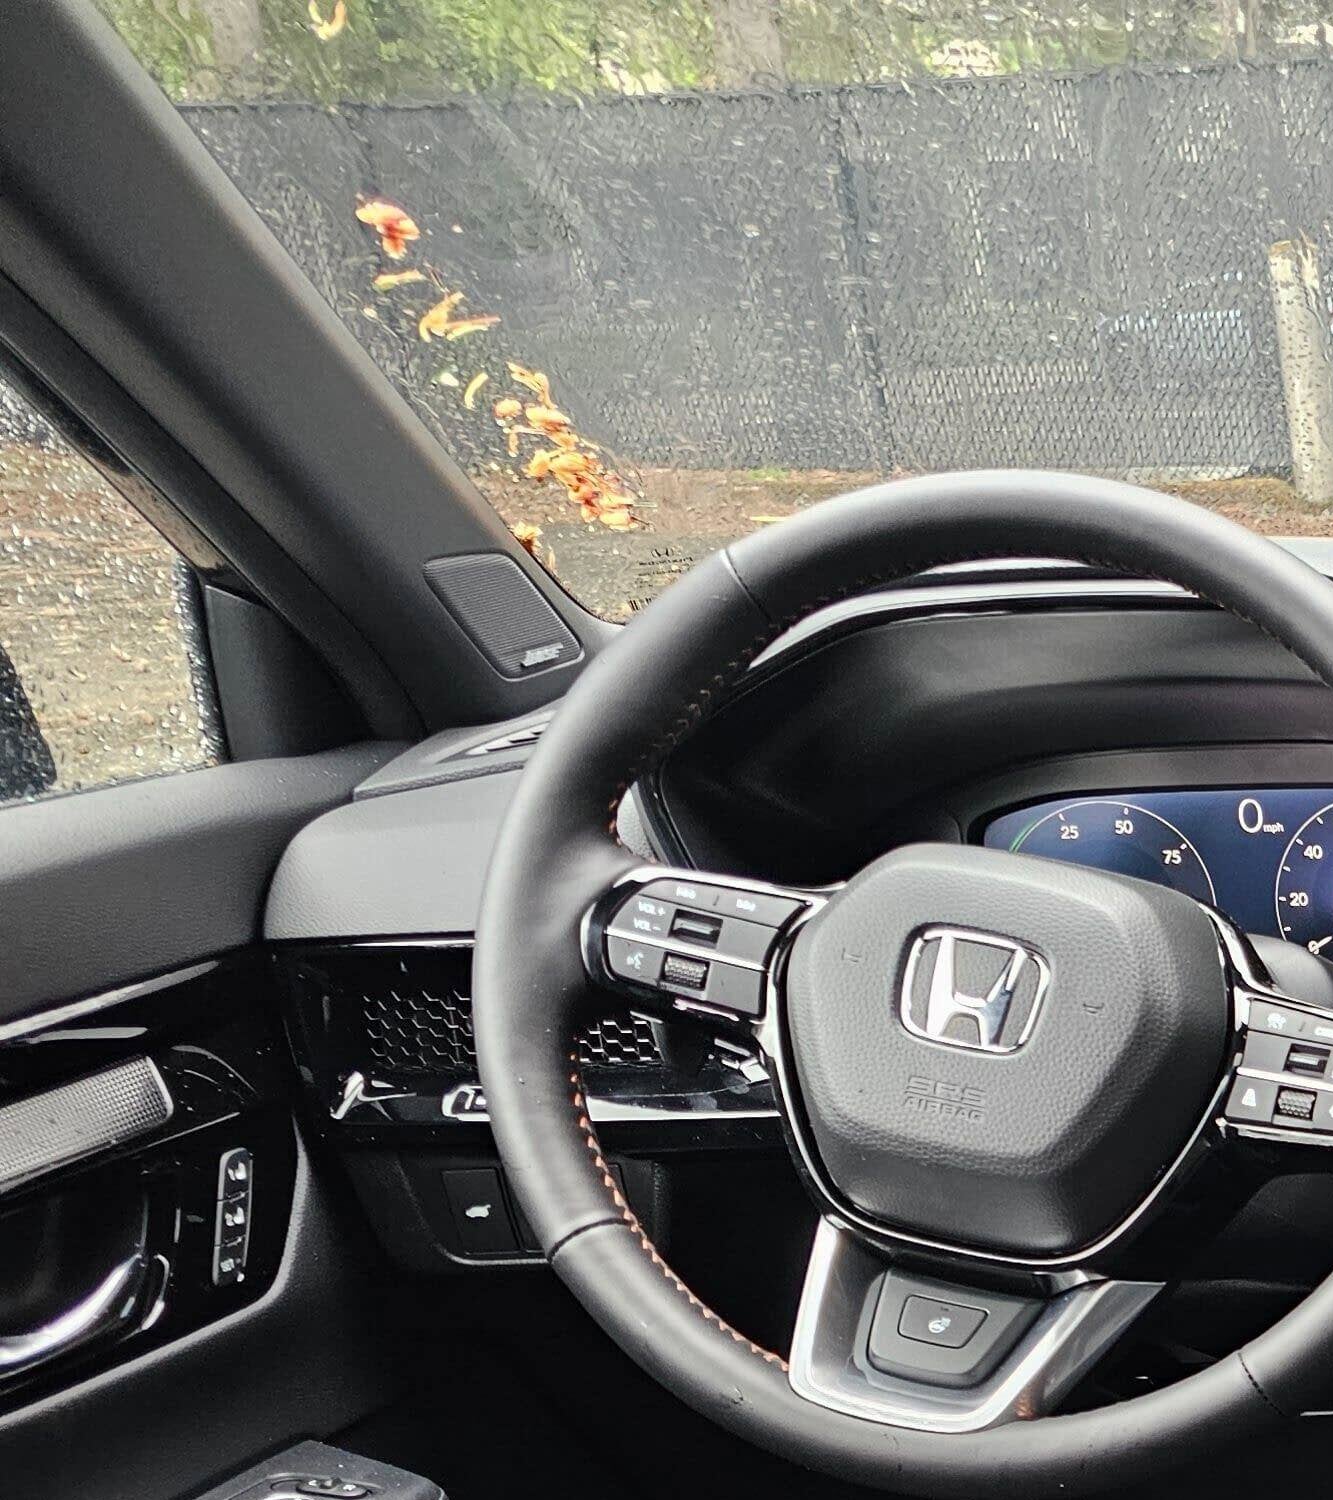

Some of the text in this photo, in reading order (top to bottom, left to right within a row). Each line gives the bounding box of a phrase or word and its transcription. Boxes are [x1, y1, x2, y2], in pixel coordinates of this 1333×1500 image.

[1238, 799, 1285, 835] 0 mph
[1060, 825, 1079, 840] 25
[1114, 820, 1134, 835] 50
[1162, 850, 1182, 865] 75
[1303, 845, 1324, 860] 40
[1289, 892, 1309, 908] 20
[906, 1074, 987, 1103] SRS
[902, 1095, 986, 1120] AIRBAG
